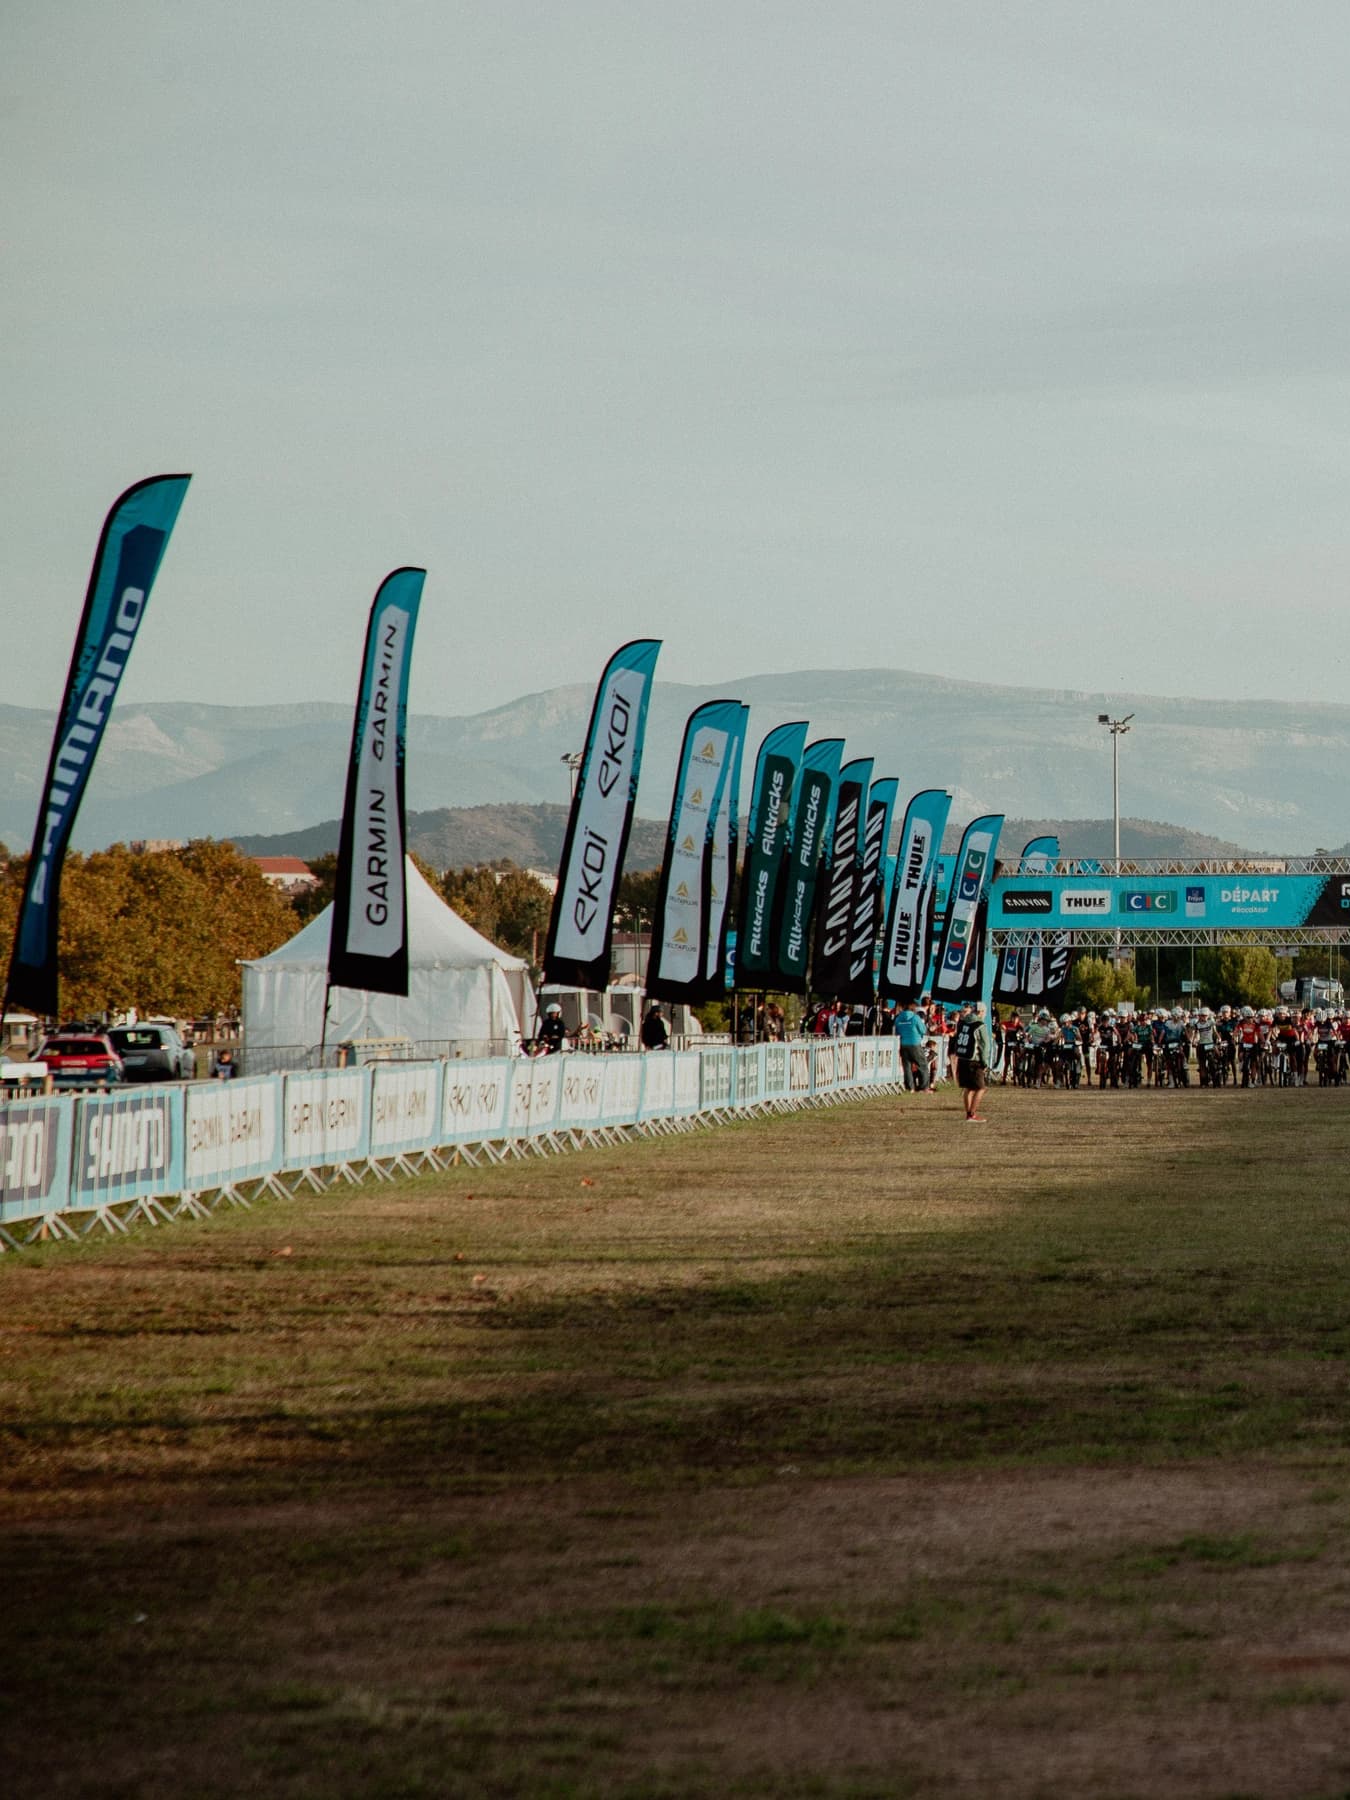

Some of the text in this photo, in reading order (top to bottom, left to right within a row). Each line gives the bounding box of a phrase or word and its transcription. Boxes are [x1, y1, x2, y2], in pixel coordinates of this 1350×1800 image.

[373, 624, 397, 763] GARMIN
[762, 769, 785, 856] Alltricks
[799, 784, 822, 867] Alltricks
[366, 790, 388, 927] GARMIN
[906, 834, 925, 890] THULE
[963, 853, 983, 897] CIC
[750, 870, 769, 957] Alltricks
[788, 879, 805, 962] Alltricks
[1005, 897, 1050, 907] CANYON
[1066, 897, 1106, 908] THULE
[1130, 895, 1167, 909] CIC
[1221, 886, 1279, 903] DÉPART
[893, 910, 912, 967] THULE
[947, 924, 967, 967] CIC
